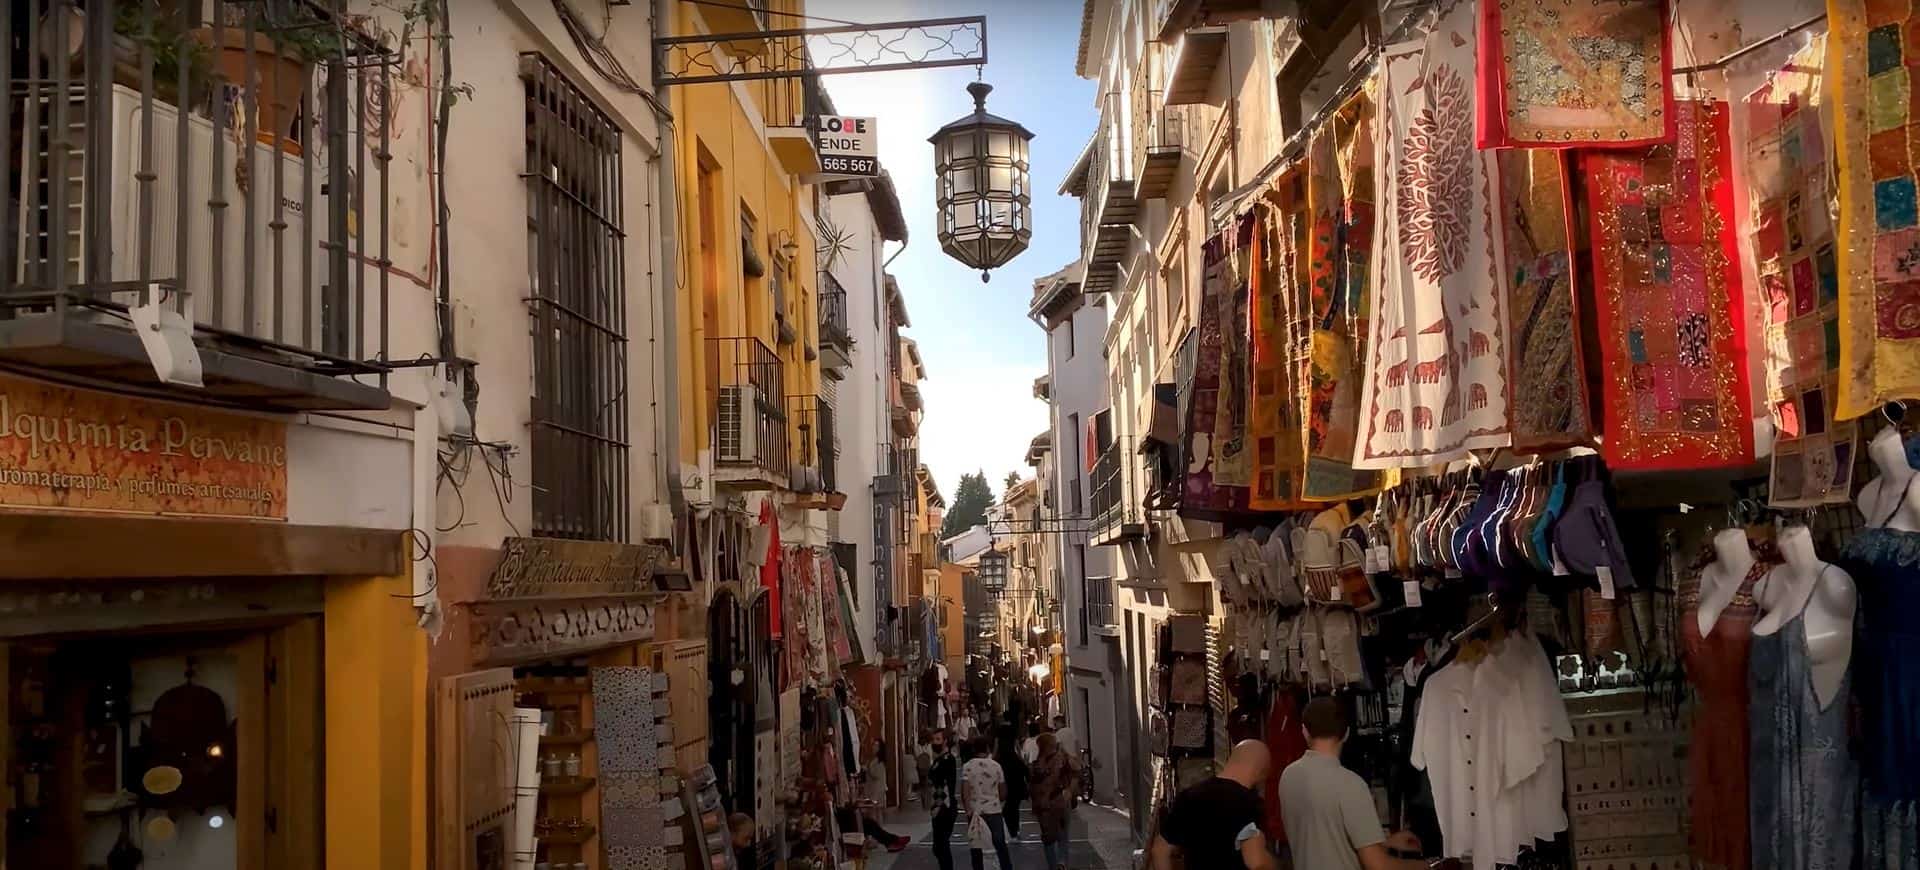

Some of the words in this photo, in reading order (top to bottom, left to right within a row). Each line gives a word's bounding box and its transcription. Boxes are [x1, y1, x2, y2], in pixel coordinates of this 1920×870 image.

[820, 138, 861, 151] ENDE
[824, 158, 848, 171] 565
[850, 159, 874, 172] 567
[160, 417, 286, 467] Pervane
[129, 472, 195, 503] perfumes
